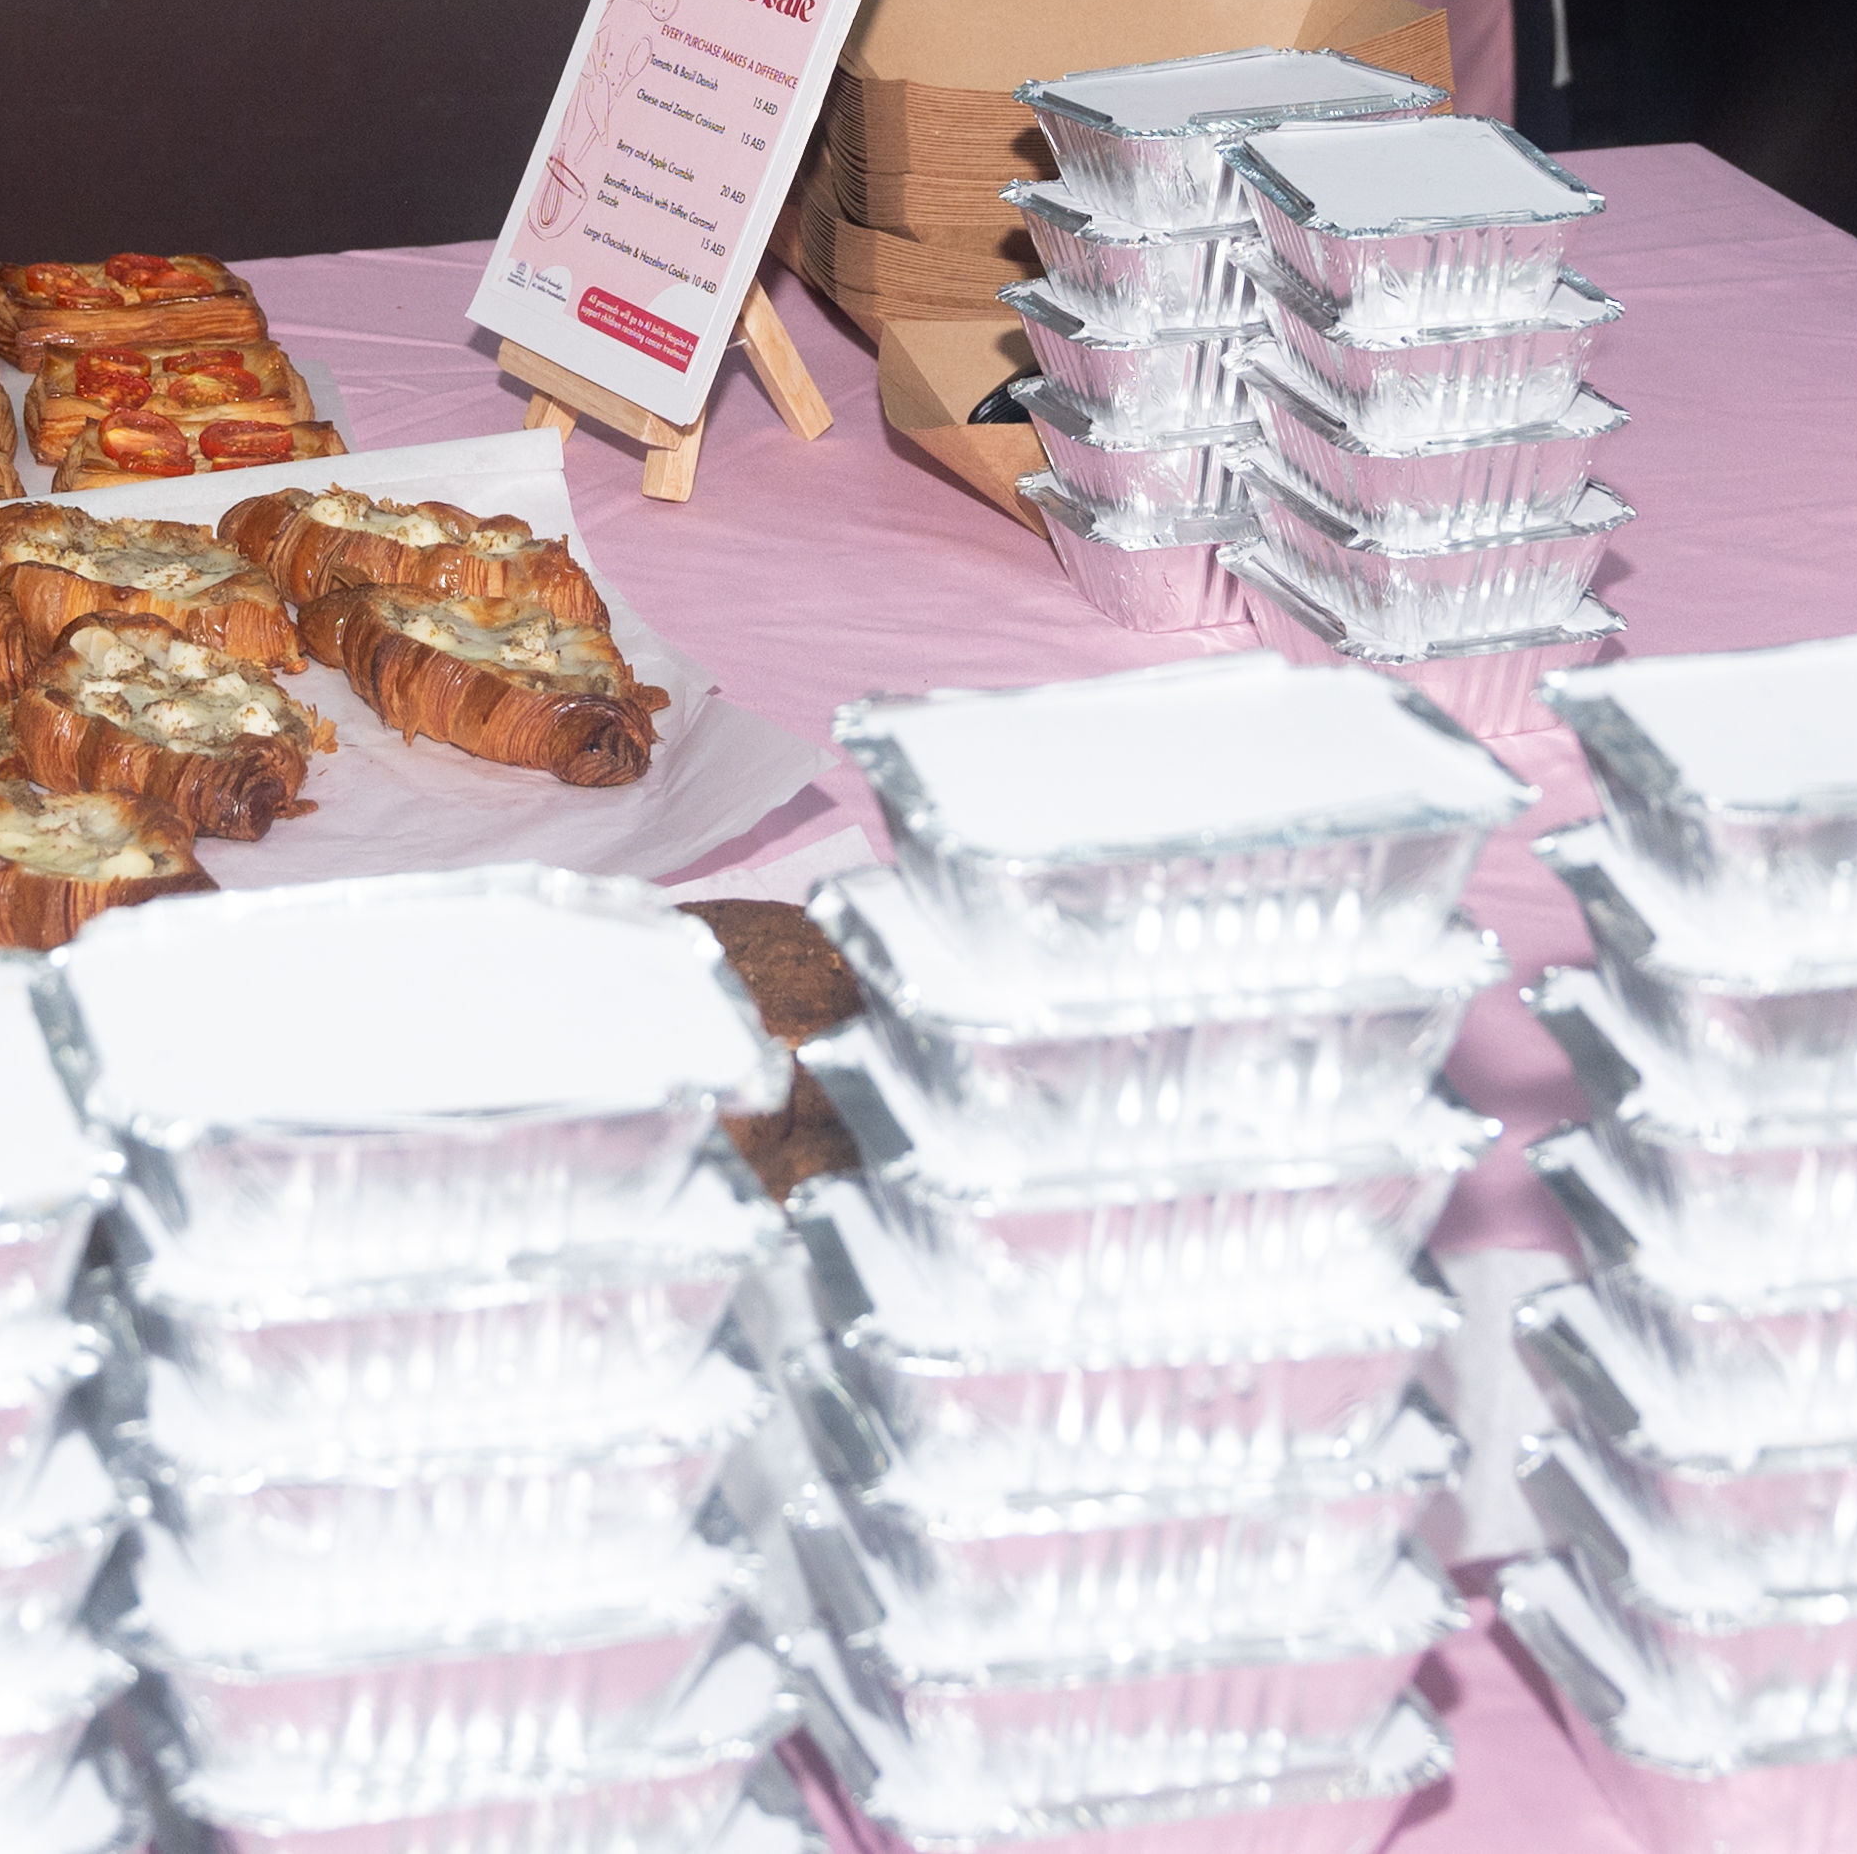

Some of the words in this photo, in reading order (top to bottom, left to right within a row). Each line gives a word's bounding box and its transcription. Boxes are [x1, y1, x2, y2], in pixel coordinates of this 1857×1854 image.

[650, 53, 672, 72] Tomato
[673, 64, 679, 75] &
[679, 66, 697, 81] Basil
[695, 73, 718, 91] Danish
[661, 24, 684, 41] EVERY
[683, 33, 722, 58] PURCHASE
[720, 49, 748, 68] MAKES
[747, 60, 754, 72] A
[754, 62, 798, 89] DIFFERENCE
[637, 88, 659, 106] Cheese
[659, 101, 674, 112] and
[672, 103, 694, 121] Zaatar
[695, 113, 725, 134] Croissant
[753, 97, 763, 109] 15
[762, 101, 778, 115] AED
[616, 139, 634, 157] Berry
[634, 150, 649, 161] and
[647, 153, 667, 170] Apple
[668, 162, 694, 182] Crumble
[741, 132, 751, 145] 15
[749, 137, 765, 151] AED
[597, 190, 619, 208] Drizzle
[603, 173, 631, 194] Banoffee
[632, 185, 653, 203] Danish
[654, 198, 668, 211] with
[669, 202, 688, 220] Toffee
[689, 211, 718, 232] Caramel
[720, 184, 730, 197] 20
[730, 190, 745, 204] AED
[583, 224, 601, 242] Large
[602, 232, 632, 255] Chocolate
[633, 247, 639, 258] &
[639, 250, 668, 271] Hazelnut
[668, 264, 690, 282] Cookie
[692, 274, 702, 287] 10
[701, 280, 717, 294] AED
[700, 237, 711, 250] 15
[709, 242, 725, 256] AED
